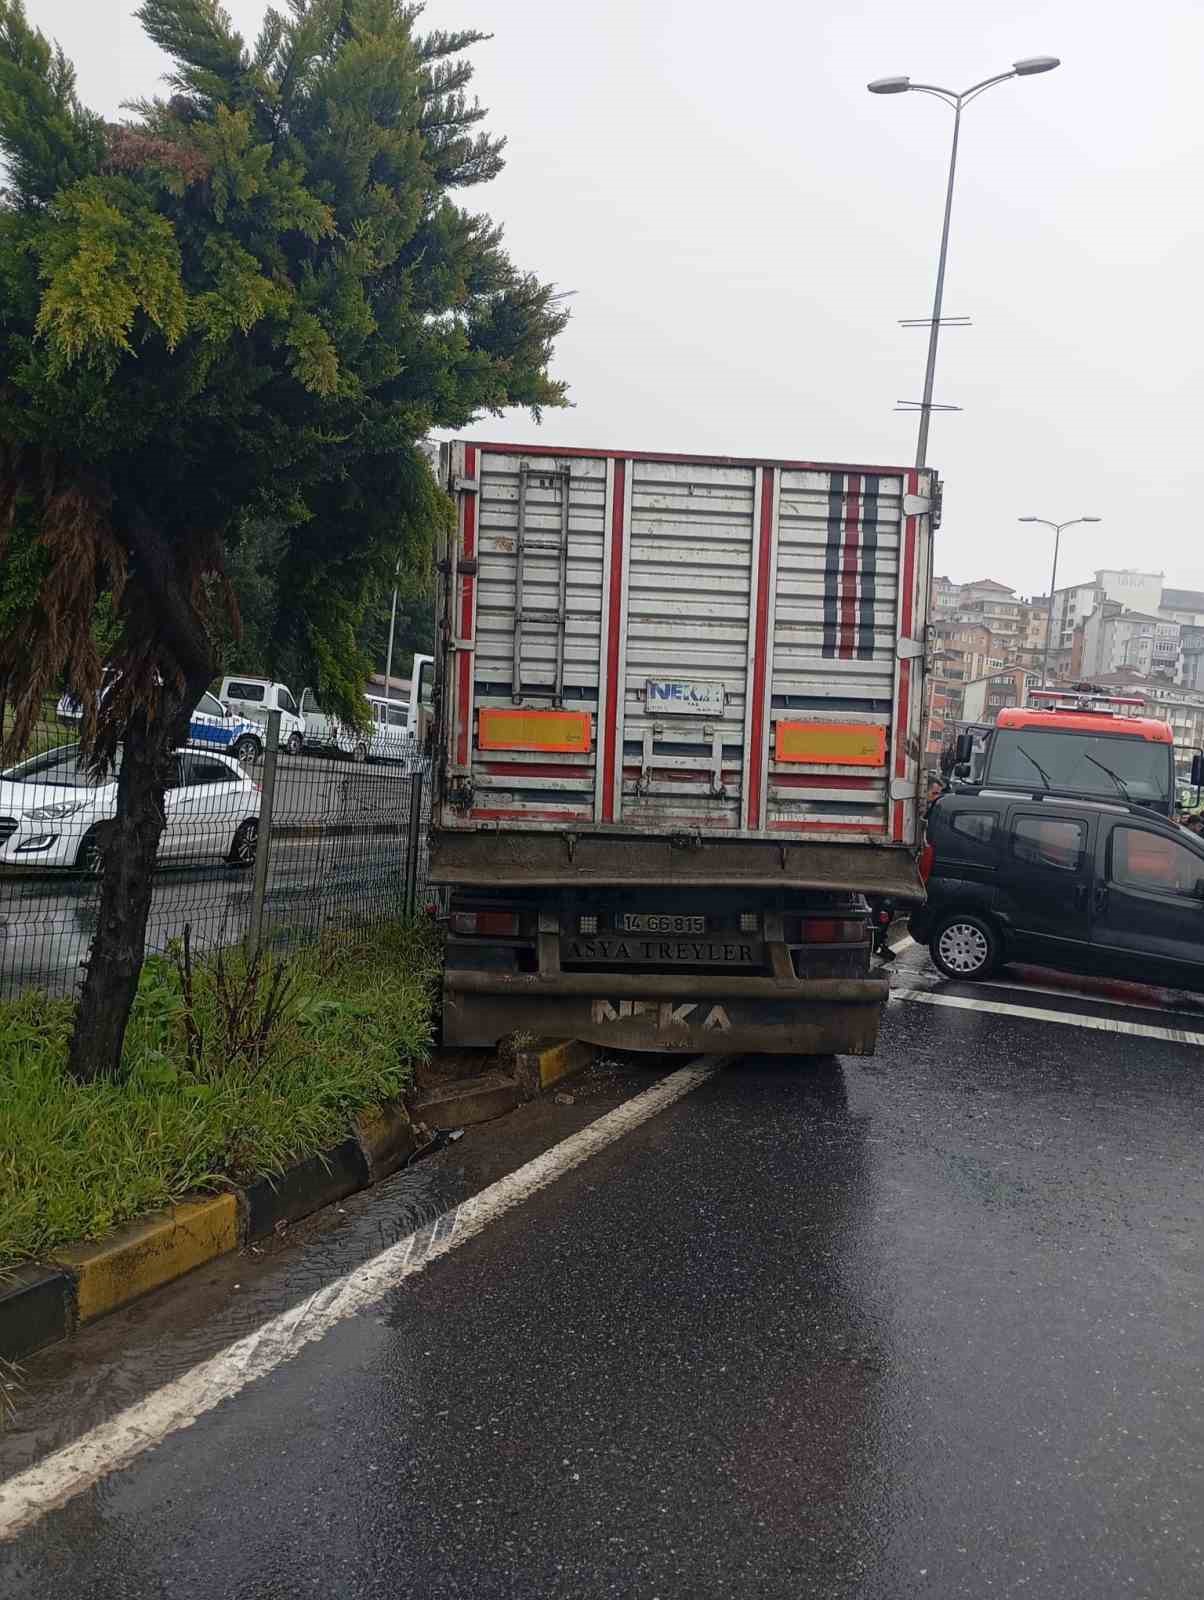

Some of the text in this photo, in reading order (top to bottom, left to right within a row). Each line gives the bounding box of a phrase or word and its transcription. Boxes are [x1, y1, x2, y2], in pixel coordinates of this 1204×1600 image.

[625, 915, 641, 930] 14
[674, 917, 704, 932] 815
[567, 941, 753, 961] ASYA TREYLER
